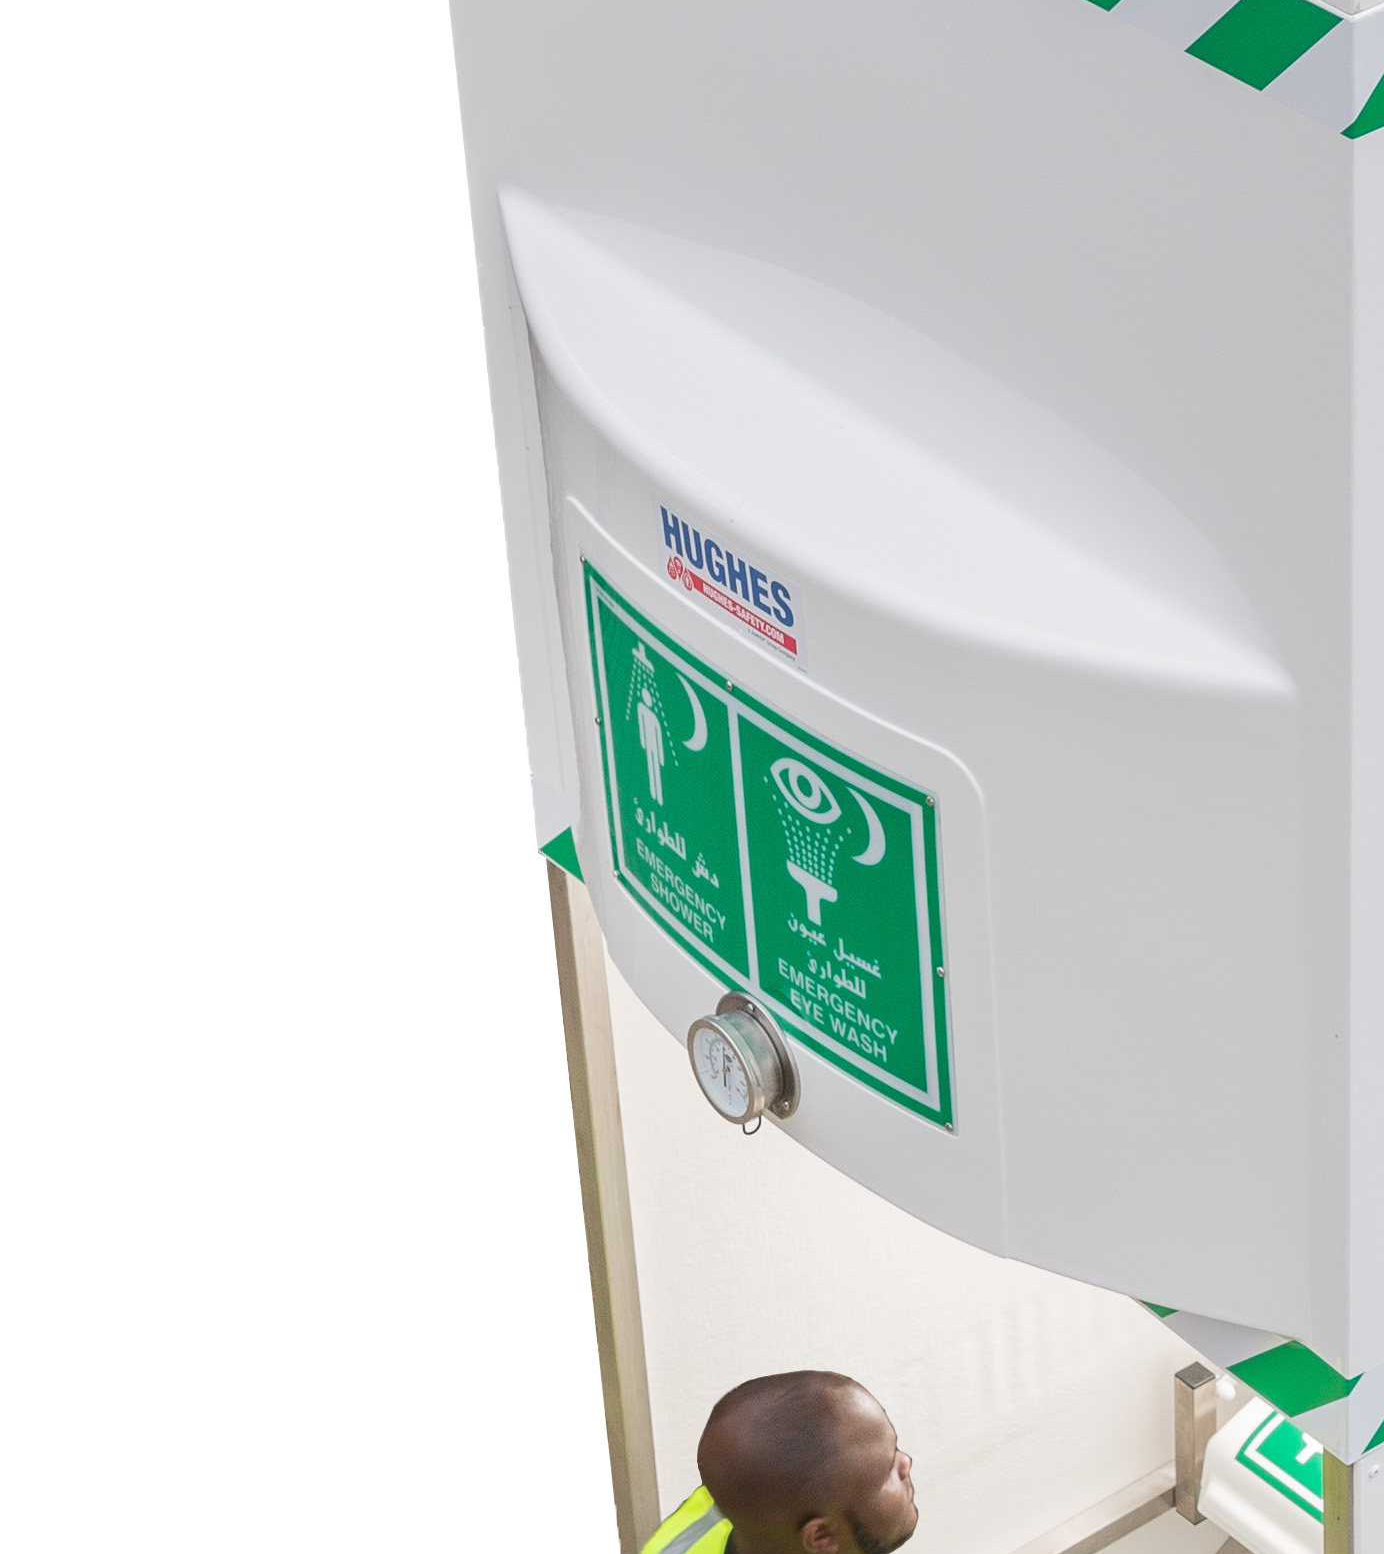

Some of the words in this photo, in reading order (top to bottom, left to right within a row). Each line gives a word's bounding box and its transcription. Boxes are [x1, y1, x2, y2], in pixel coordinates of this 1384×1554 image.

[660, 505, 794, 627] HUGHES
[703, 582, 785, 644] HUGHES-SAFETY.COM
[635, 836, 726, 930] EMERGENCY
[650, 872, 714, 943] SHOWER
[787, 912, 827, 946] عيون
[833, 937, 882, 979] غسيل
[778, 957, 898, 1045] EMERGENCY
[790, 987, 825, 1025] EYE
[829, 1013, 887, 1062] WASH
